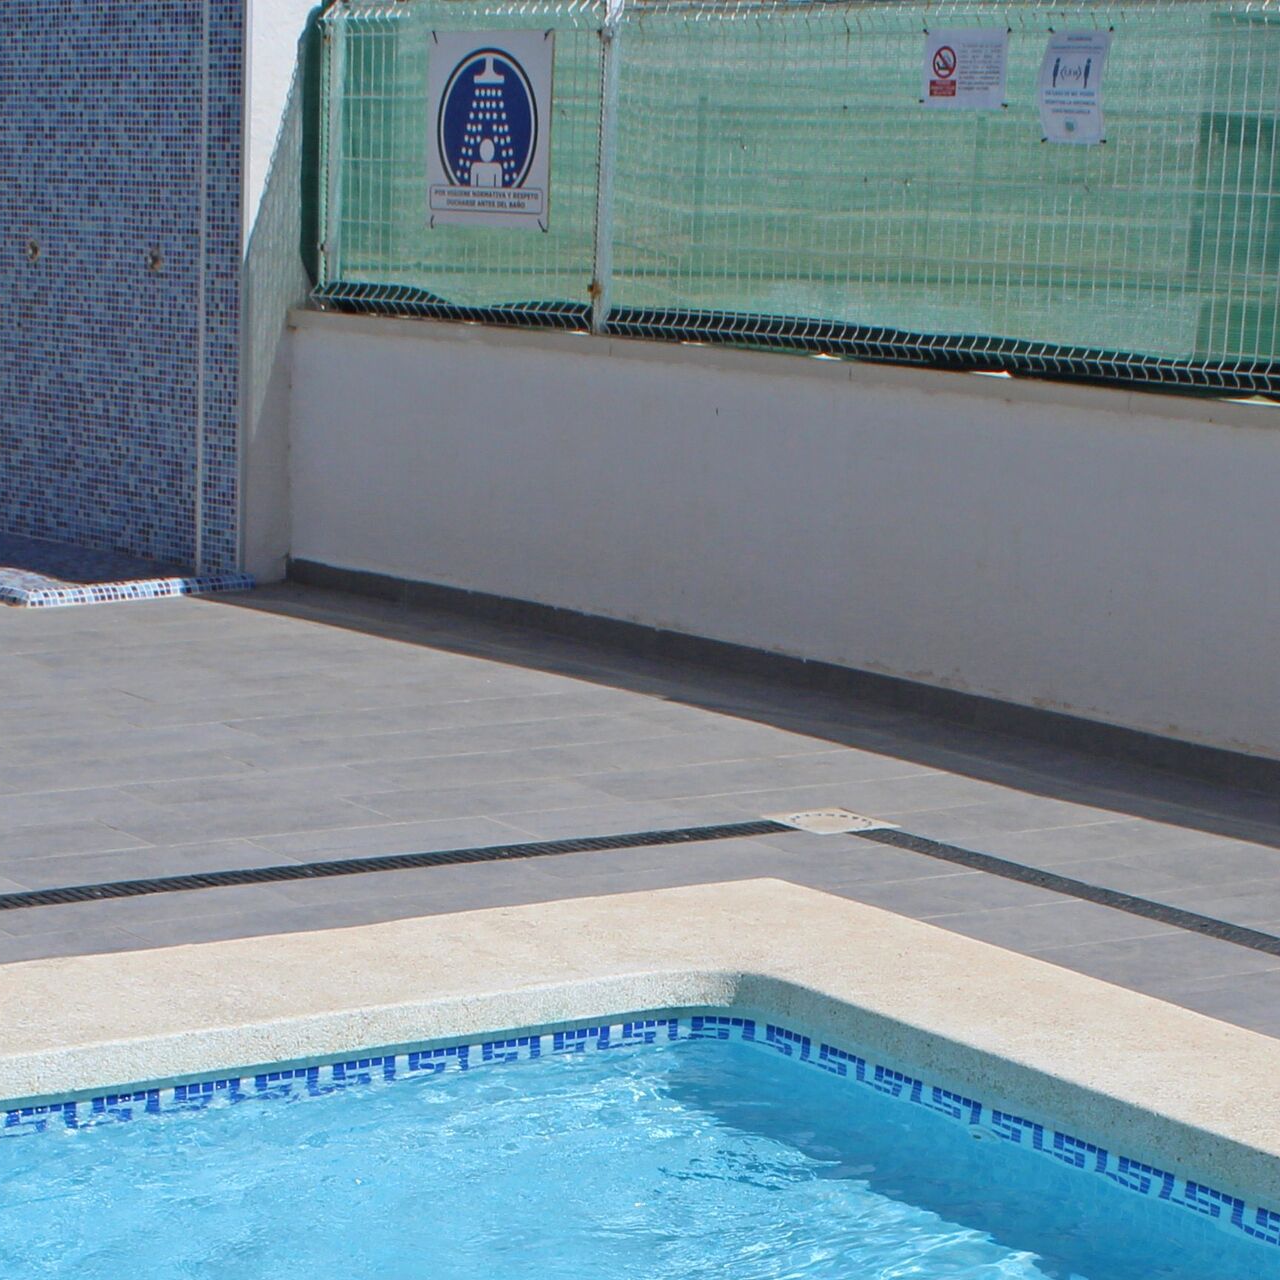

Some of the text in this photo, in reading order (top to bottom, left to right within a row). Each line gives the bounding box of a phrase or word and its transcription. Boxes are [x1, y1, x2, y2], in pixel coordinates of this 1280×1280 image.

[471, 190, 505, 198] NORMATIVA
[512, 191, 538, 199] RESPETO
[446, 198, 525, 208] DUCHARSE ANTES DEL BAÑO
